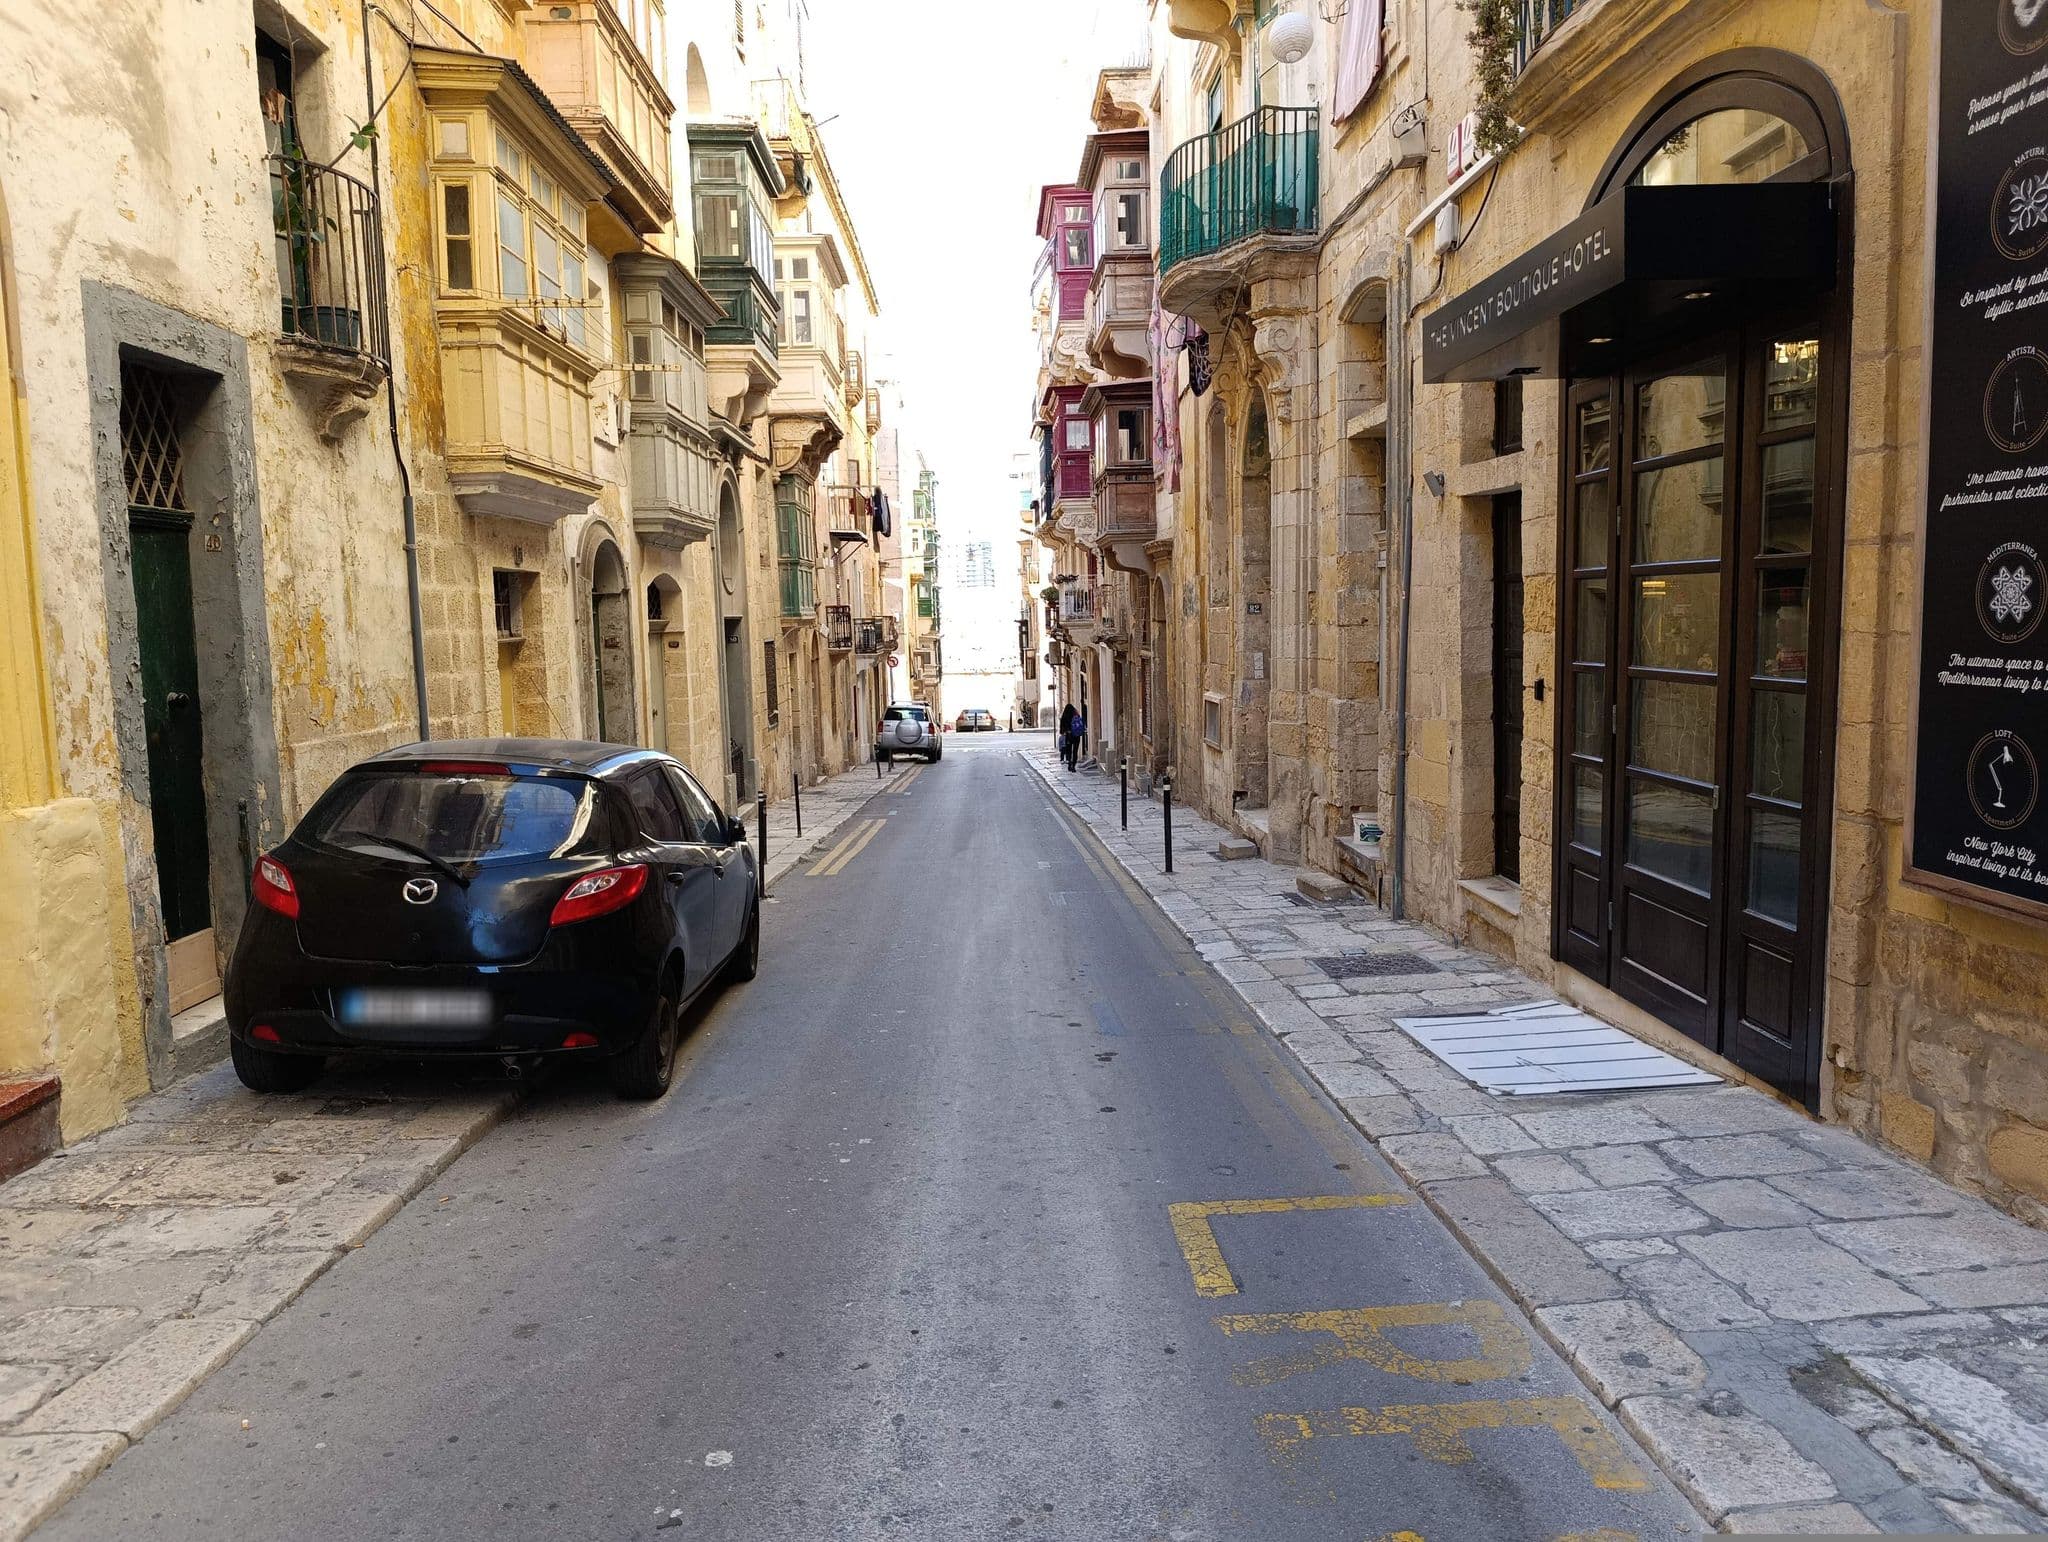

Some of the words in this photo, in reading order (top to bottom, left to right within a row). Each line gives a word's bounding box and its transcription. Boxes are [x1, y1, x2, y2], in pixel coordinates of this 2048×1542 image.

[2002, 77, 2029, 104] your
[2000, 98, 2026, 125] your
[2014, 147, 2045, 166] NATURA
[1430, 325, 1447, 349] THE
[1450, 297, 1493, 341] VINCENT
[1497, 257, 1559, 317] BOUTIQUE
[1563, 227, 1611, 280] HOTEL
[1960, 291, 1974, 307] Be
[1974, 278, 2014, 303] inspired
[2014, 275, 2028, 294] by
[1984, 300, 2014, 321] idyllic
[2007, 346, 2036, 361] ARTISTA
[1965, 472, 1984, 487] The
[1985, 467, 2023, 483] ultimate
[1940, 489, 1993, 512] fashionistas
[1994, 486, 2014, 501] and
[1987, 542, 2038, 563] MEDITERRANEA
[1948, 653, 1966, 667] The
[1967, 657, 2004, 669] ultimate
[2005, 660, 2032, 673] space
[2033, 660, 2044, 671] to
[1938, 671, 2002, 687] Mediterranean
[2003, 675, 2030, 693] living
[2031, 677, 2042, 690] to
[1994, 730, 2012, 738] LOFT
[1964, 836, 1988, 851] New
[1990, 841, 2015, 858] York
[2017, 846, 2037, 867] City
[1946, 849, 1982, 866] inspired
[1982, 858, 2007, 878] living
[2009, 866, 2021, 878] at
[2020, 868, 2033, 881] its
